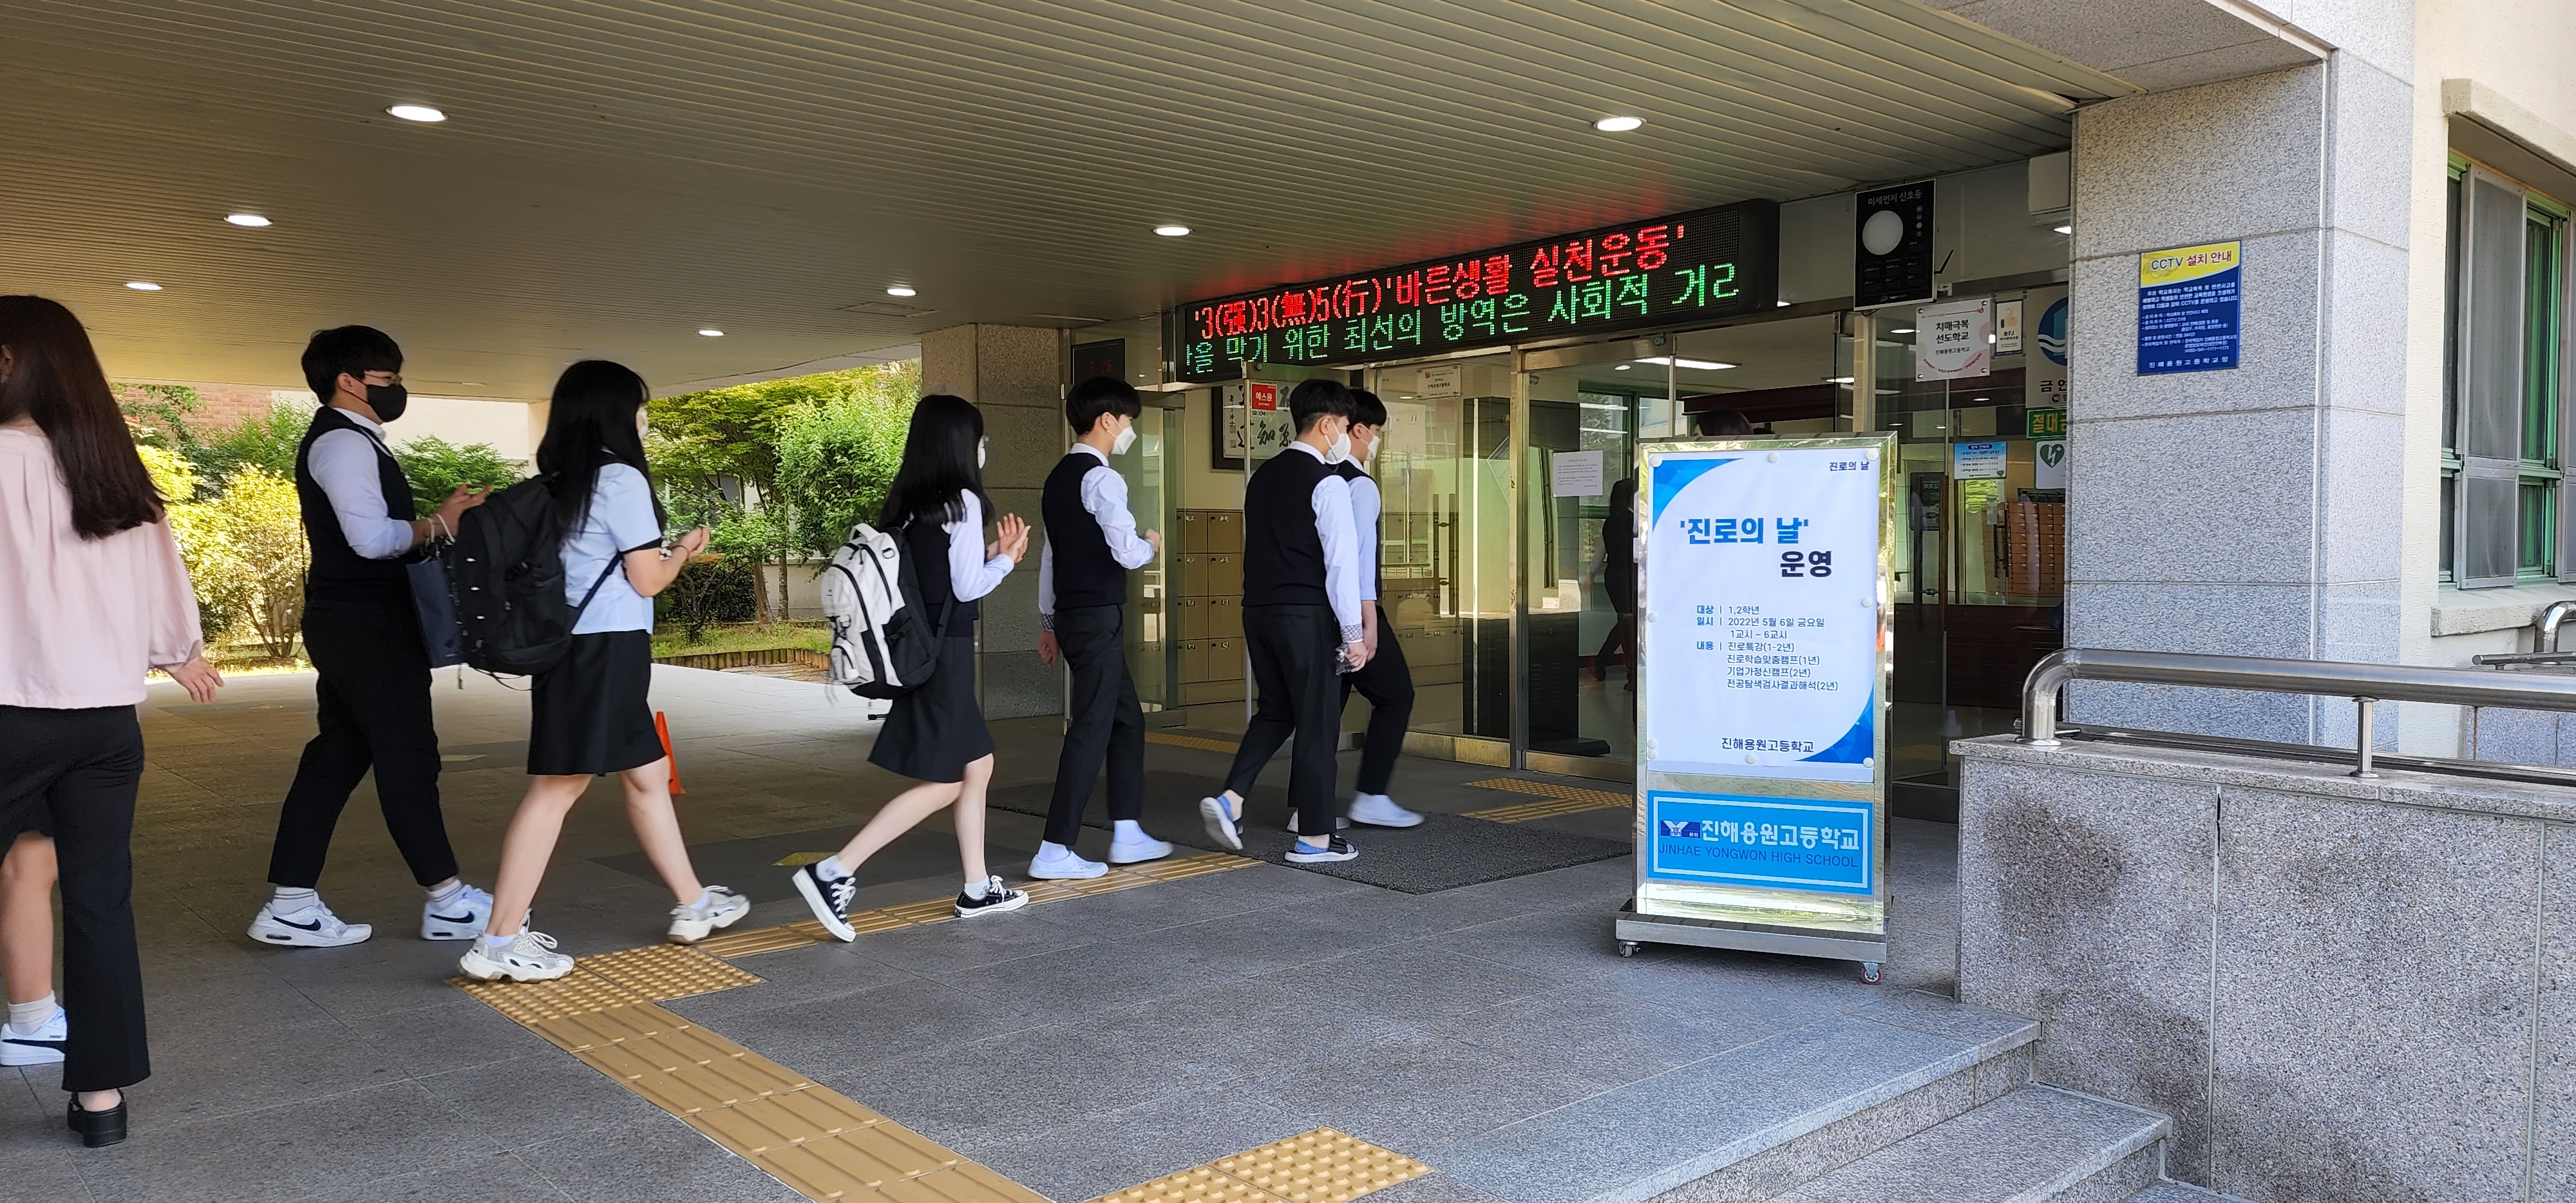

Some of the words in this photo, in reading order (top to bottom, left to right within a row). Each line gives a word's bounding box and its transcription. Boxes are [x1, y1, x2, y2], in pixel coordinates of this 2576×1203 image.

[1899, 189, 1922, 202] 신호등
[1530, 223, 1685, 288] 실천운동'
[2151, 256, 2184, 270] CCTV
[2186, 252, 2208, 267] 설치
[2210, 250, 2232, 264] 안내
[1226, 332, 1268, 368] 막기
[1282, 323, 1332, 361] 위한
[1343, 309, 1421, 353] 최선의
[1440, 292, 1530, 341] 방역은
[1547, 273, 1649, 325] 사회적
[1935, 319, 1970, 332] 치매극복
[1935, 331, 1970, 345] 선도학교
[1255, 392, 1273, 402] 에스원
[1829, 461, 1857, 471] 진로의
[1861, 460, 1870, 471] 날
[1680, 517, 1764, 545] '진로의
[1776, 517, 1809, 544] 날'
[1780, 550, 1832, 578] 운영
[1696, 605, 1714, 614] 대상
[1728, 605, 1760, 615] 1,2학년
[1696, 616, 1714, 626] 일시
[1728, 617, 1759, 627] 2022년
[1762, 618, 1777, 627] 5월
[1779, 618, 1795, 627] 6일
[1797, 618, 1825, 628] 금요일
[1730, 629, 1753, 639] 1교시
[1764, 630, 1788, 639] 6교시
[1696, 641, 1714, 650] 내용
[1728, 641, 1795, 653] 진로특강(1-2년)
[1727, 654, 1821, 666] 진로학습맞춤캠프(1년)
[1727, 666, 1812, 678] 기업가정신캠프(2년)
[1727, 678, 1839, 692] 전공탐색검사결과해석(2년)
[1721, 737, 1814, 754] 진해용원고등학교
[1701, 819, 1860, 851] 진해용원고등학교
[1659, 843, 1701, 857] JINHAE
[1707, 846, 1766, 862] YONGWON
[1771, 851, 1801, 864] HIGH
[1805, 853, 1859, 867] SCHOOL
